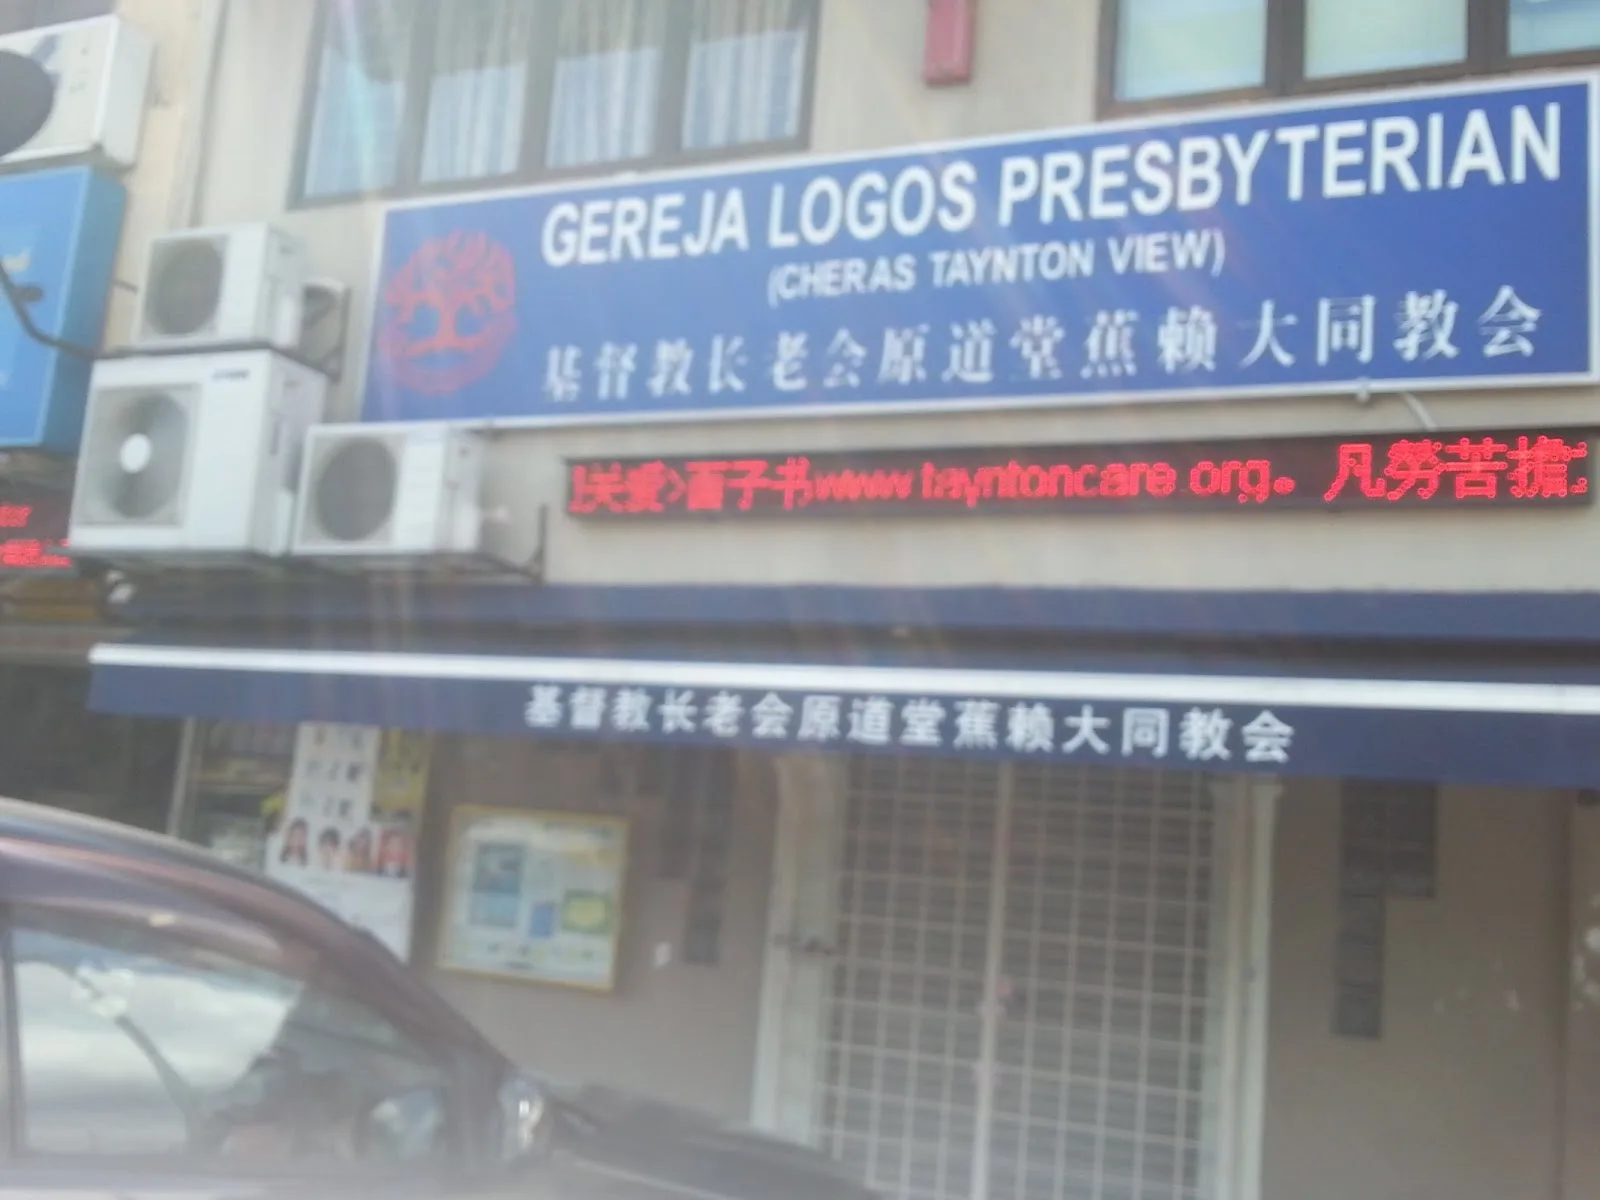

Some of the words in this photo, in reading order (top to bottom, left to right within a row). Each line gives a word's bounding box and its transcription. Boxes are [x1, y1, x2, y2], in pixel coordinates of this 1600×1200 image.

[541, 187, 749, 268] GEREJA
[767, 160, 978, 249] LOGOS
[998, 101, 1562, 226] PRESBYTERIAN
[767, 252, 917, 308] (CHERAS
[928, 240, 1095, 288] TAYNTON
[1107, 230, 1226, 277] VIEW)
[544, 285, 1542, 402] 基督教长老会原道堂蕉赖大同教会
[523, 684, 1296, 765] 基督教长老会原道堂蕉赖大同教会
